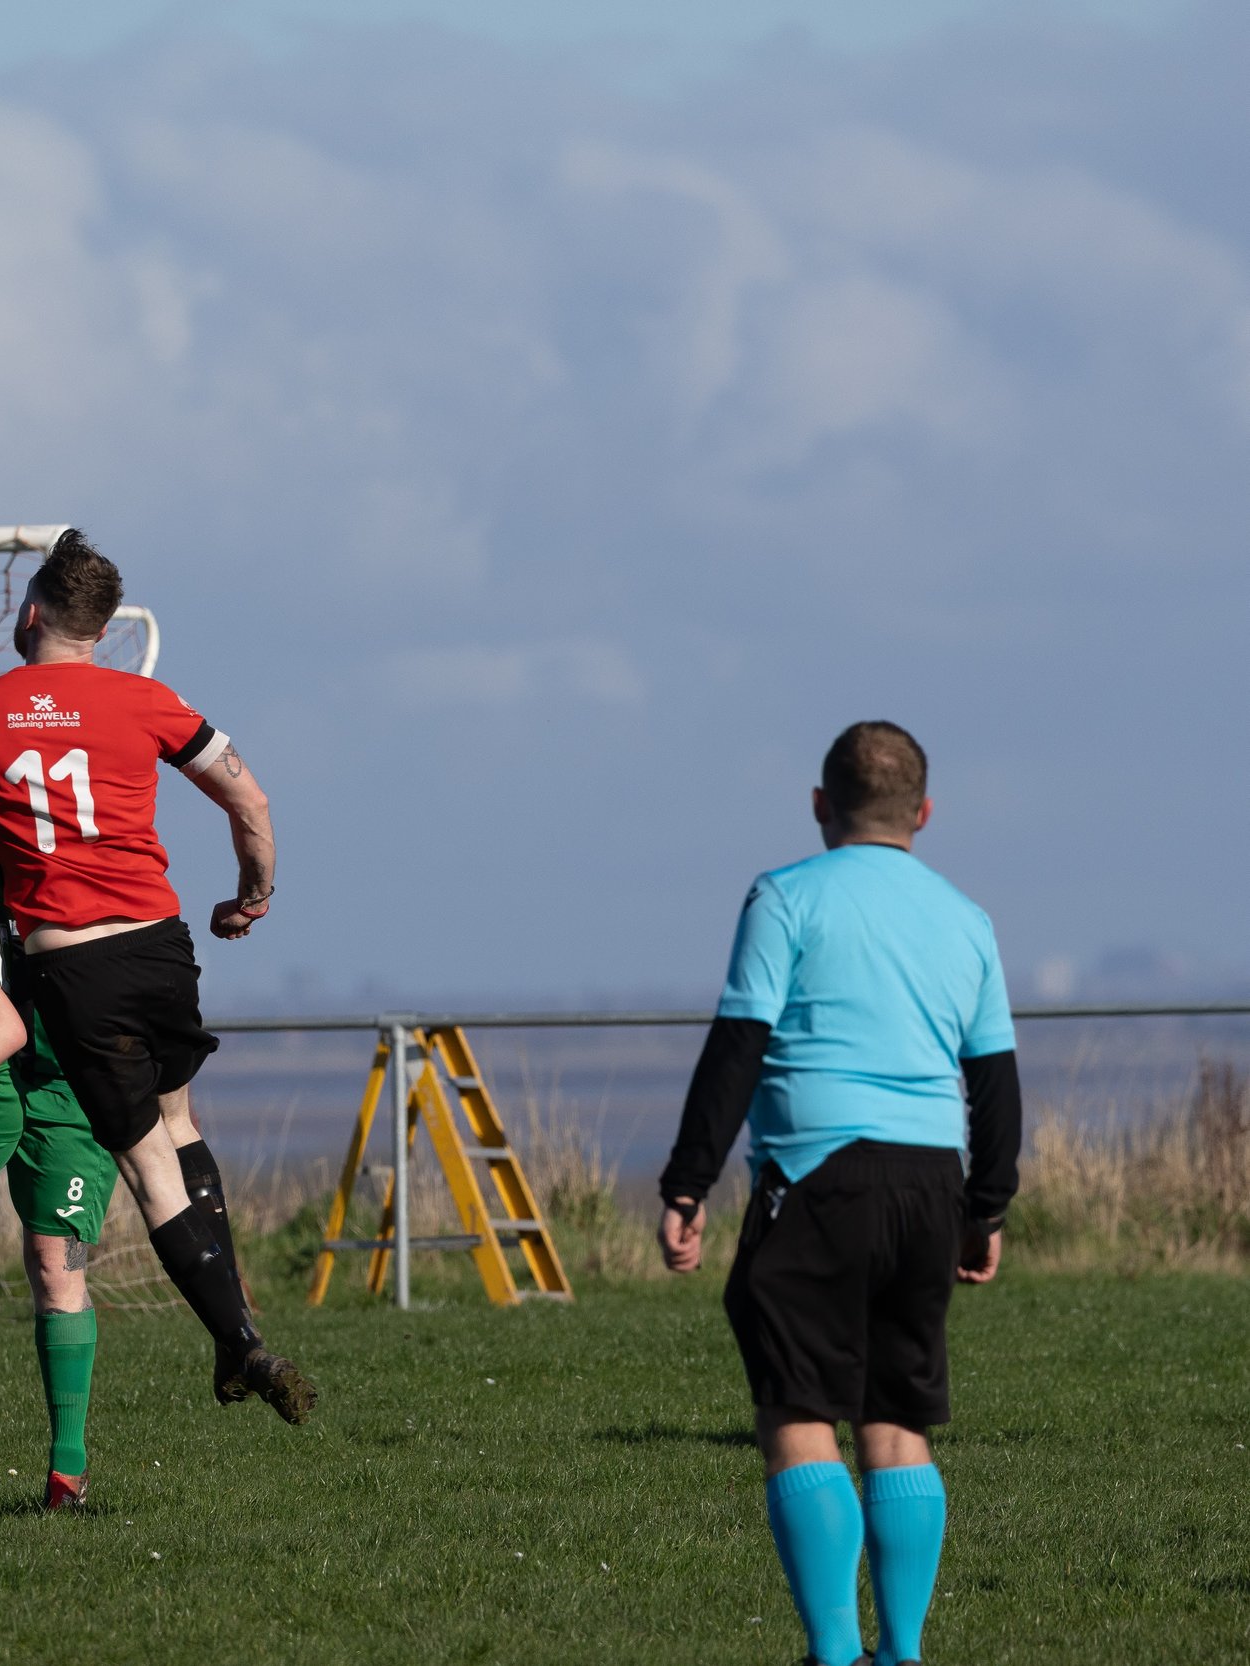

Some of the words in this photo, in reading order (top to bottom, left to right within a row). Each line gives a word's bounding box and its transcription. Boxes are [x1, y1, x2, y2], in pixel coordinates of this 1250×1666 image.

[7, 713, 24, 721] RG
[26, 711, 81, 721] HOWELLS
[7, 720, 44, 729] cleaning
[4, 748, 100, 855] 11
[67, 1176, 84, 1202] 8
